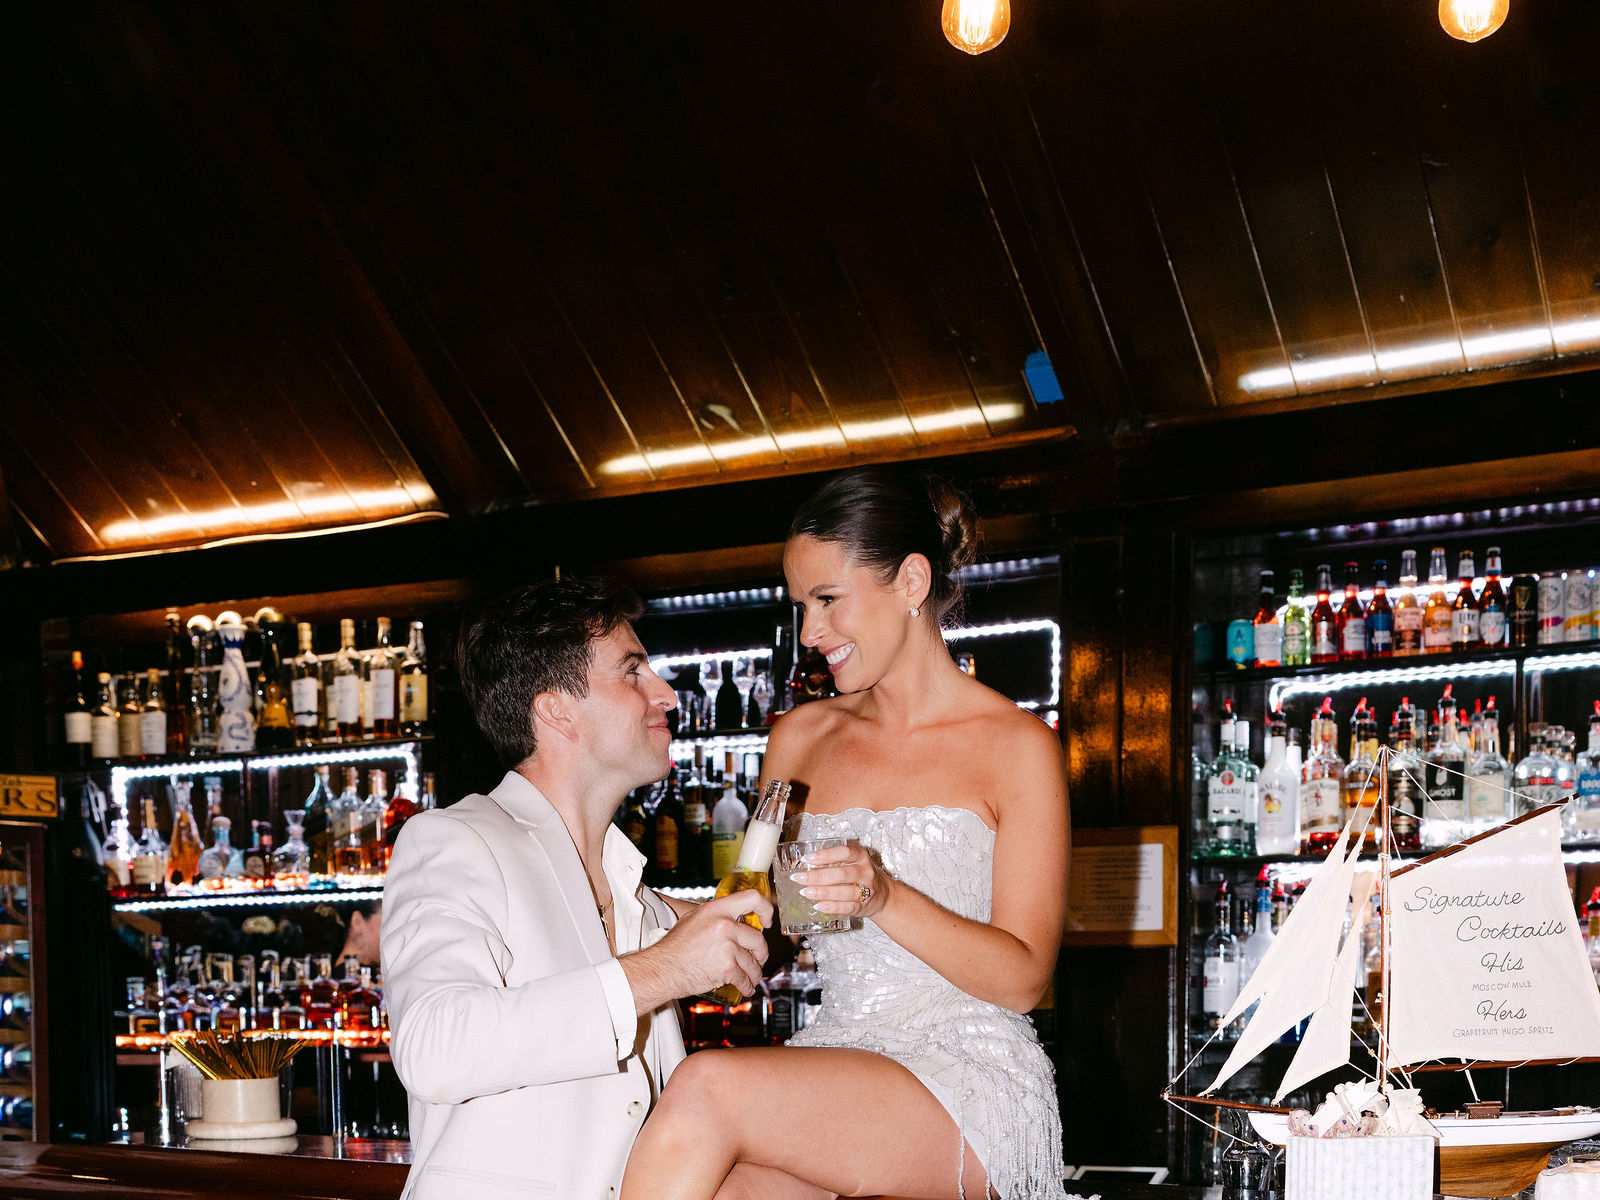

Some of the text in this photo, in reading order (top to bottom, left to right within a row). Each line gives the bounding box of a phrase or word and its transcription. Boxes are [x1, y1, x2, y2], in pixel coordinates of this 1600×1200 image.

[1404, 886, 1525, 914] Signature
[1456, 915, 1567, 942] Cocktails
[1480, 951, 1525, 973] His
[1472, 980, 1533, 991] MOSCOW MULE
[1476, 999, 1527, 1021] Hers
[1452, 1026, 1554, 1038] GRAPEFRUIT HUGO SPRITZ
